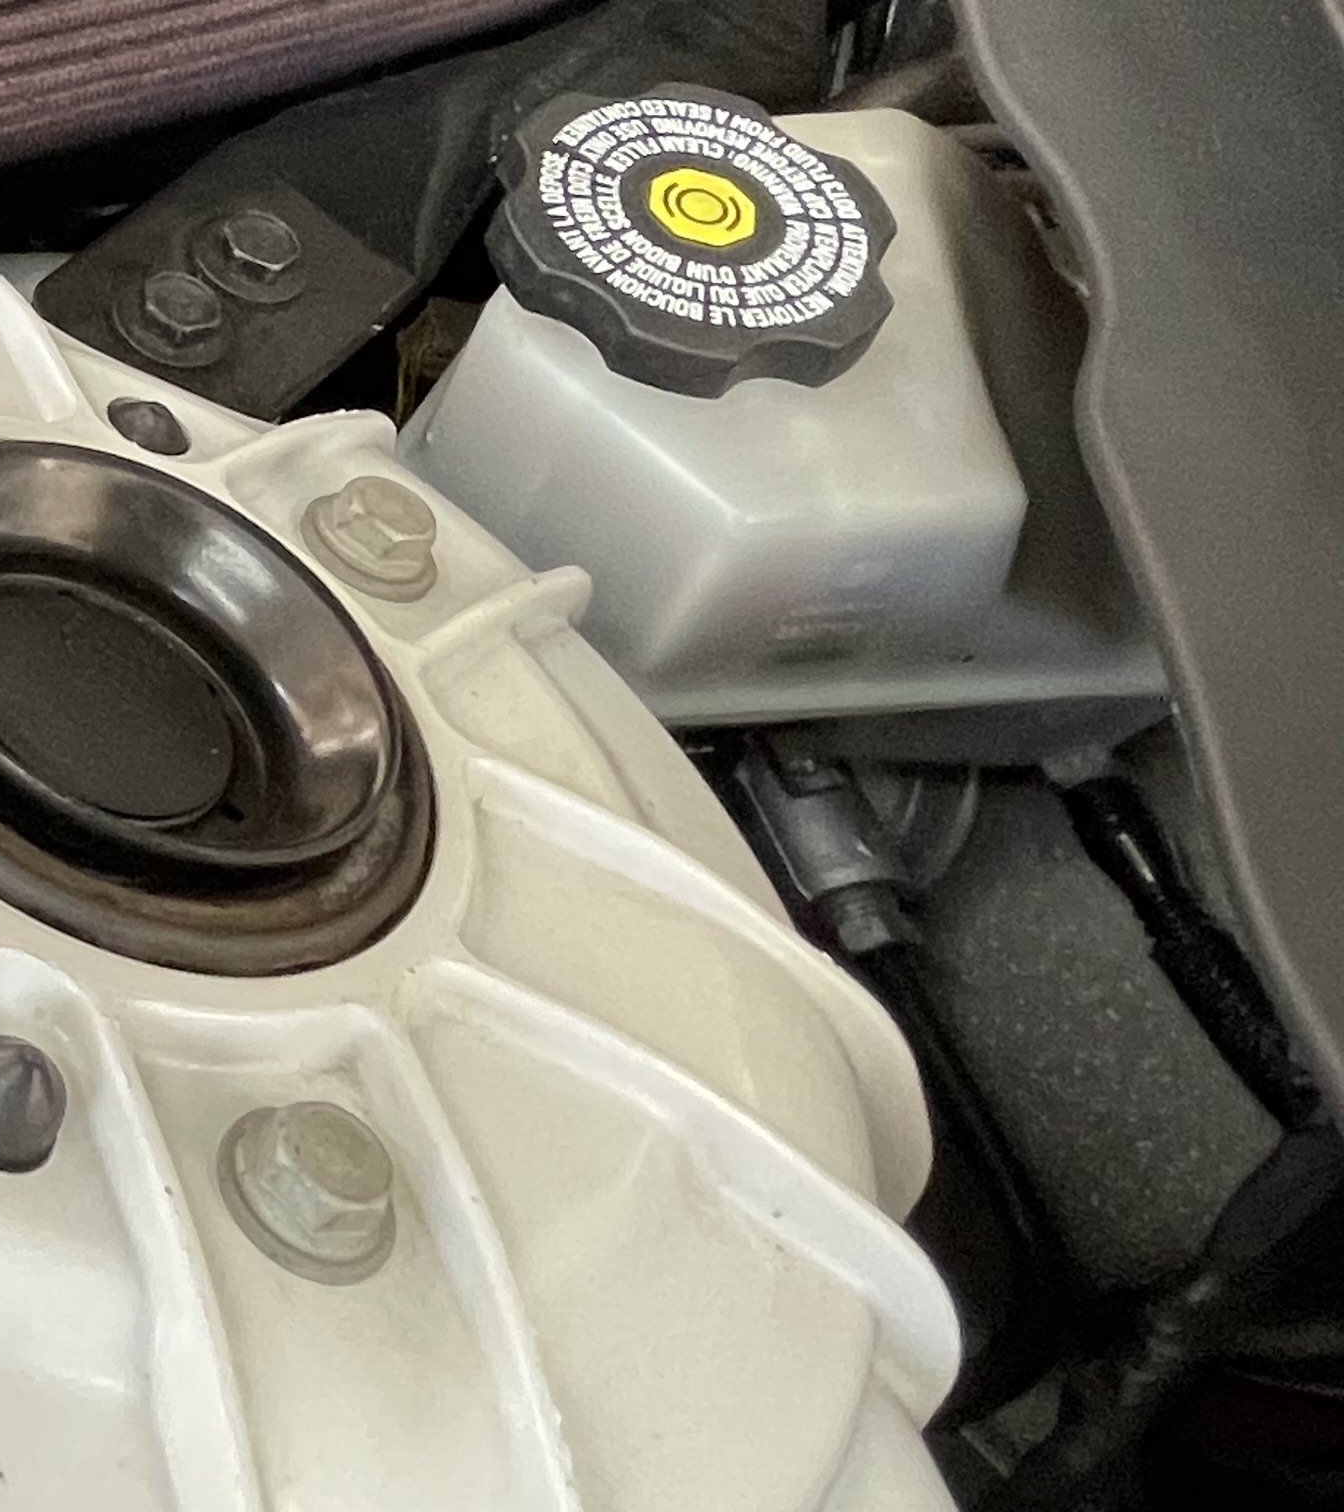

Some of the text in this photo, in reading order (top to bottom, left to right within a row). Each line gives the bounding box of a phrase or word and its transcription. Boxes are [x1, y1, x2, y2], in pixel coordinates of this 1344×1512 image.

[640, 100, 712, 121] SEALED
[716, 109, 729, 124] A
[609, 120, 649, 141] USE
[730, 115, 786, 148] FROM
[579, 131, 617, 163] ONLY
[603, 137, 661, 172] FILLER
[657, 136, 724, 158] CLEAN
[783, 143, 835, 182] FLUID
[745, 142, 816, 191] BEFORE
[547, 206, 574, 227] LA
[571, 198, 611, 241] FREIN
[801, 193, 833, 218] CAP
[558, 230, 614, 273] AVANT
[600, 240, 631, 263] DE
[620, 230, 681, 272] BIDON
[625, 257, 705, 301] LIQUIDE
[740, 284, 785, 305] QUE
[606, 270, 703, 321] BOUCHON
[710, 286, 739, 305] DU
[739, 291, 833, 327] NETTOYER
[709, 305, 736, 326] LE
